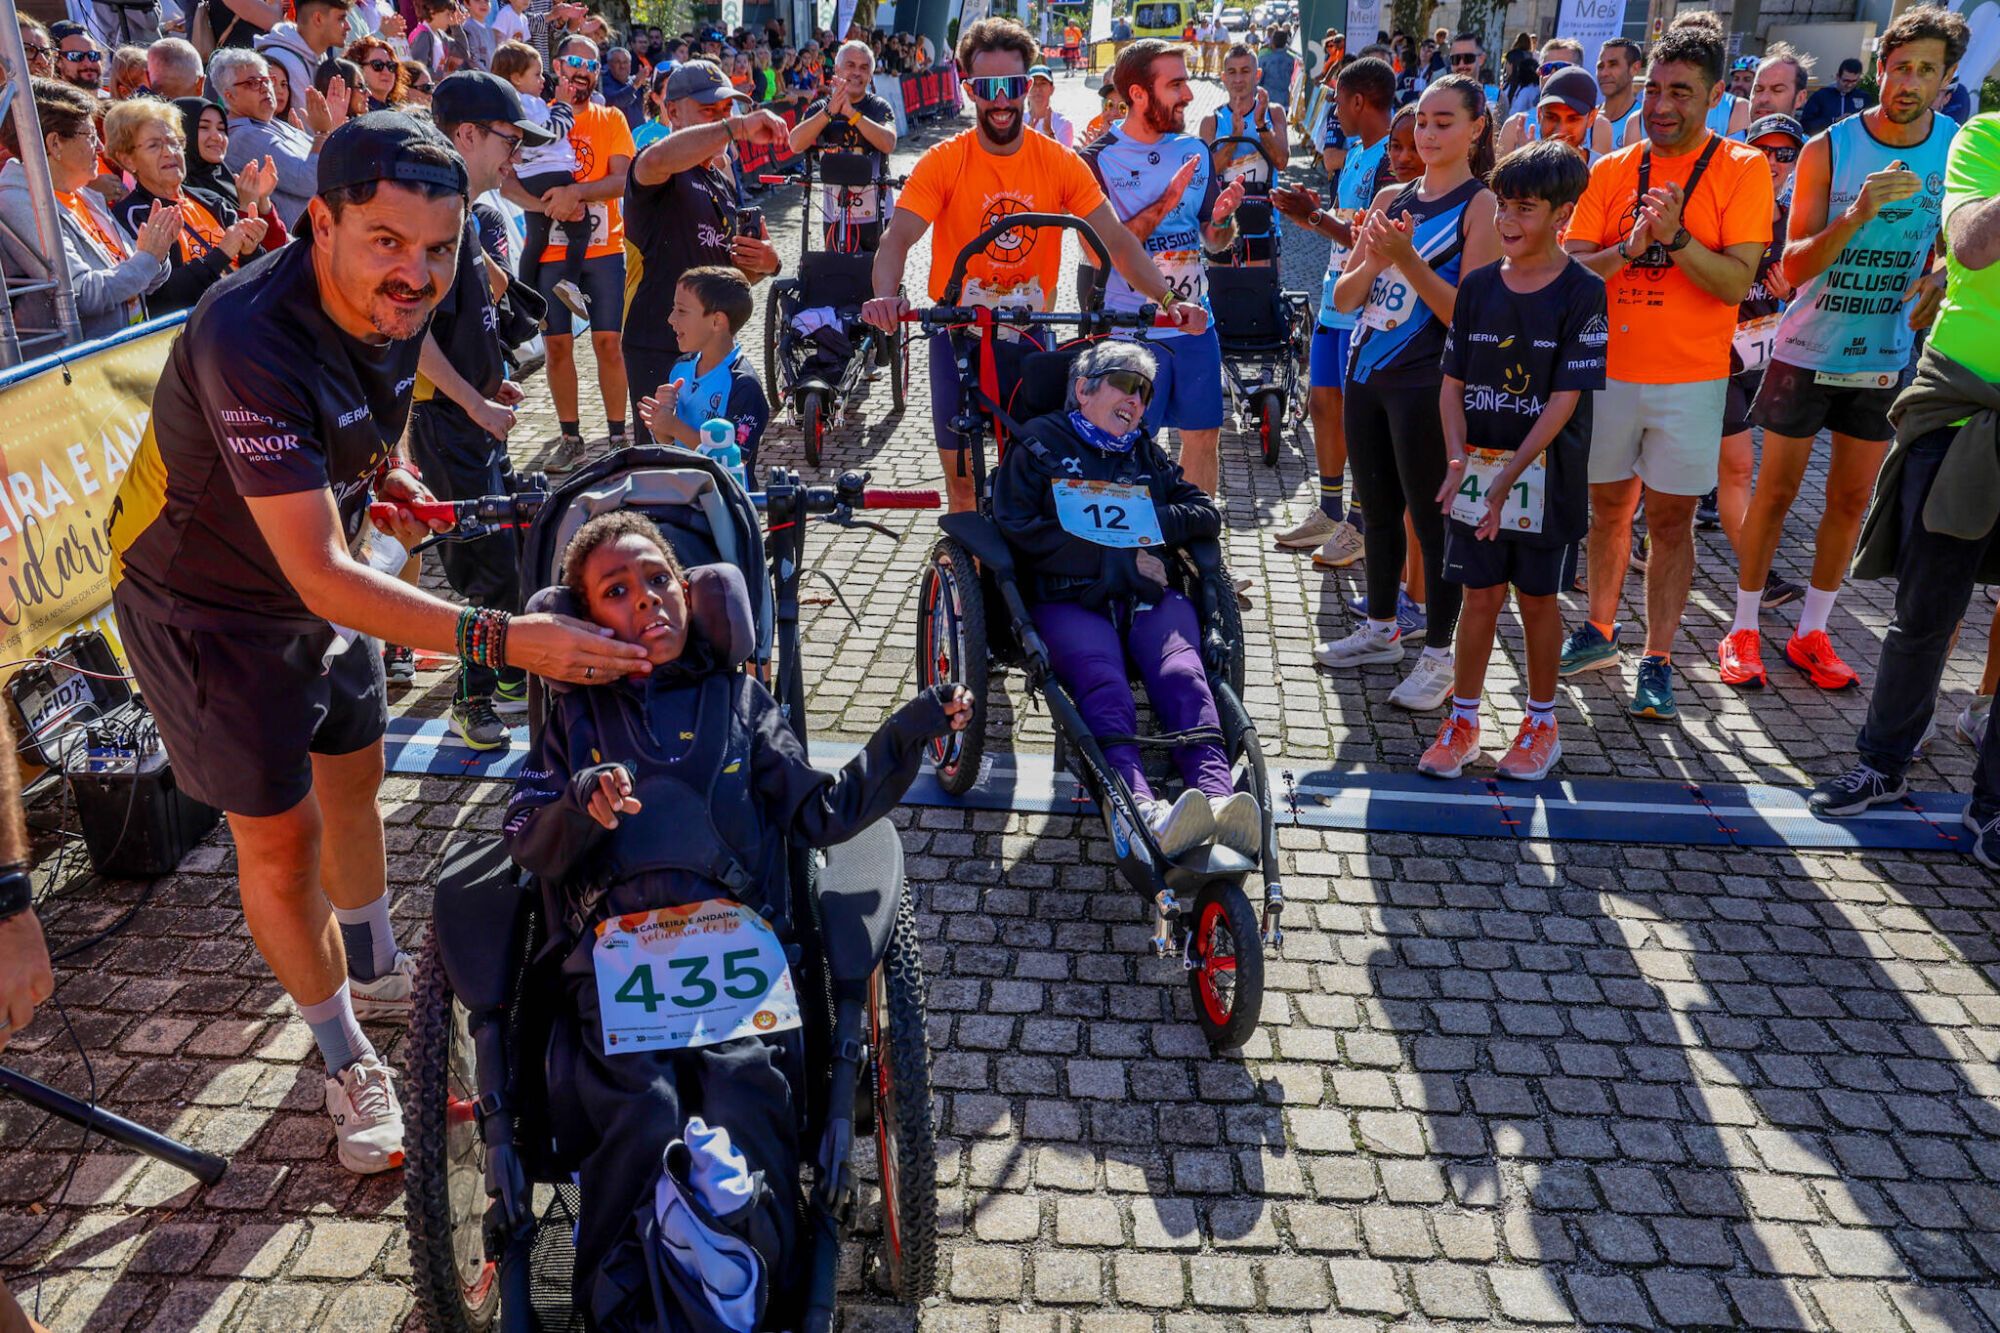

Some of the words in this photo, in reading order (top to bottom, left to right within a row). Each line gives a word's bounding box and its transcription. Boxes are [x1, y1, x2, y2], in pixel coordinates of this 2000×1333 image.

[1370, 277, 1407, 311] 568
[66, 441, 101, 497] E
[1082, 503, 1131, 531] 12
[639, 918, 686, 933] CARREIRA
[696, 910, 741, 924] ANDAINA
[614, 947, 769, 1013] 435
